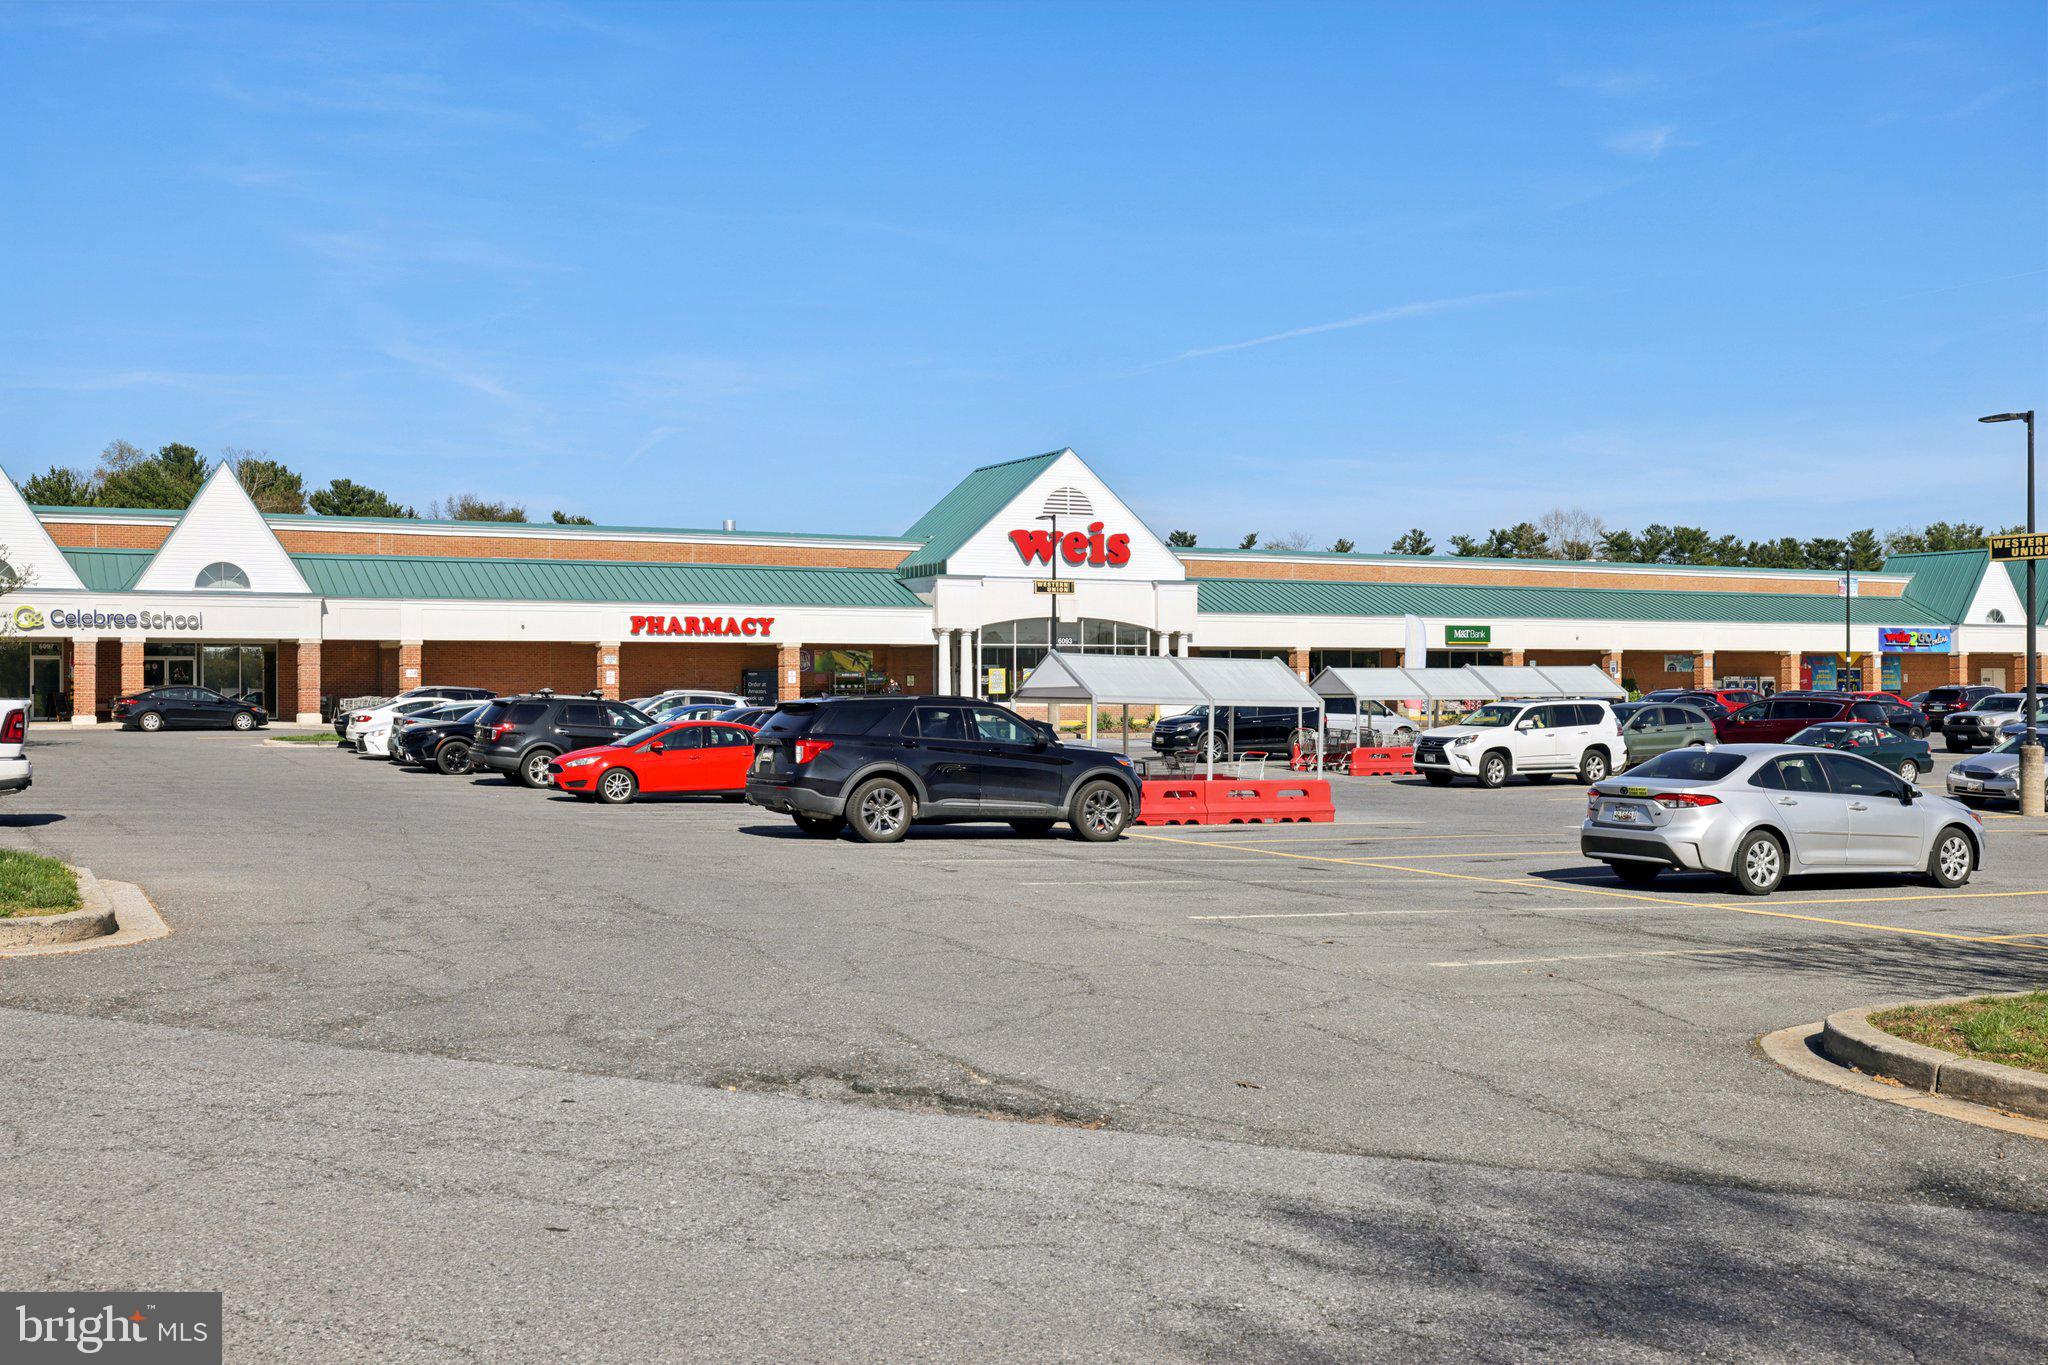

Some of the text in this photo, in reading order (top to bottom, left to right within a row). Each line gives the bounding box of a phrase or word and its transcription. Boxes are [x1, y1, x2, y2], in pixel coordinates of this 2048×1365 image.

[50, 609, 203, 631] Celebree School
[630, 615, 775, 637] PHARMACY
